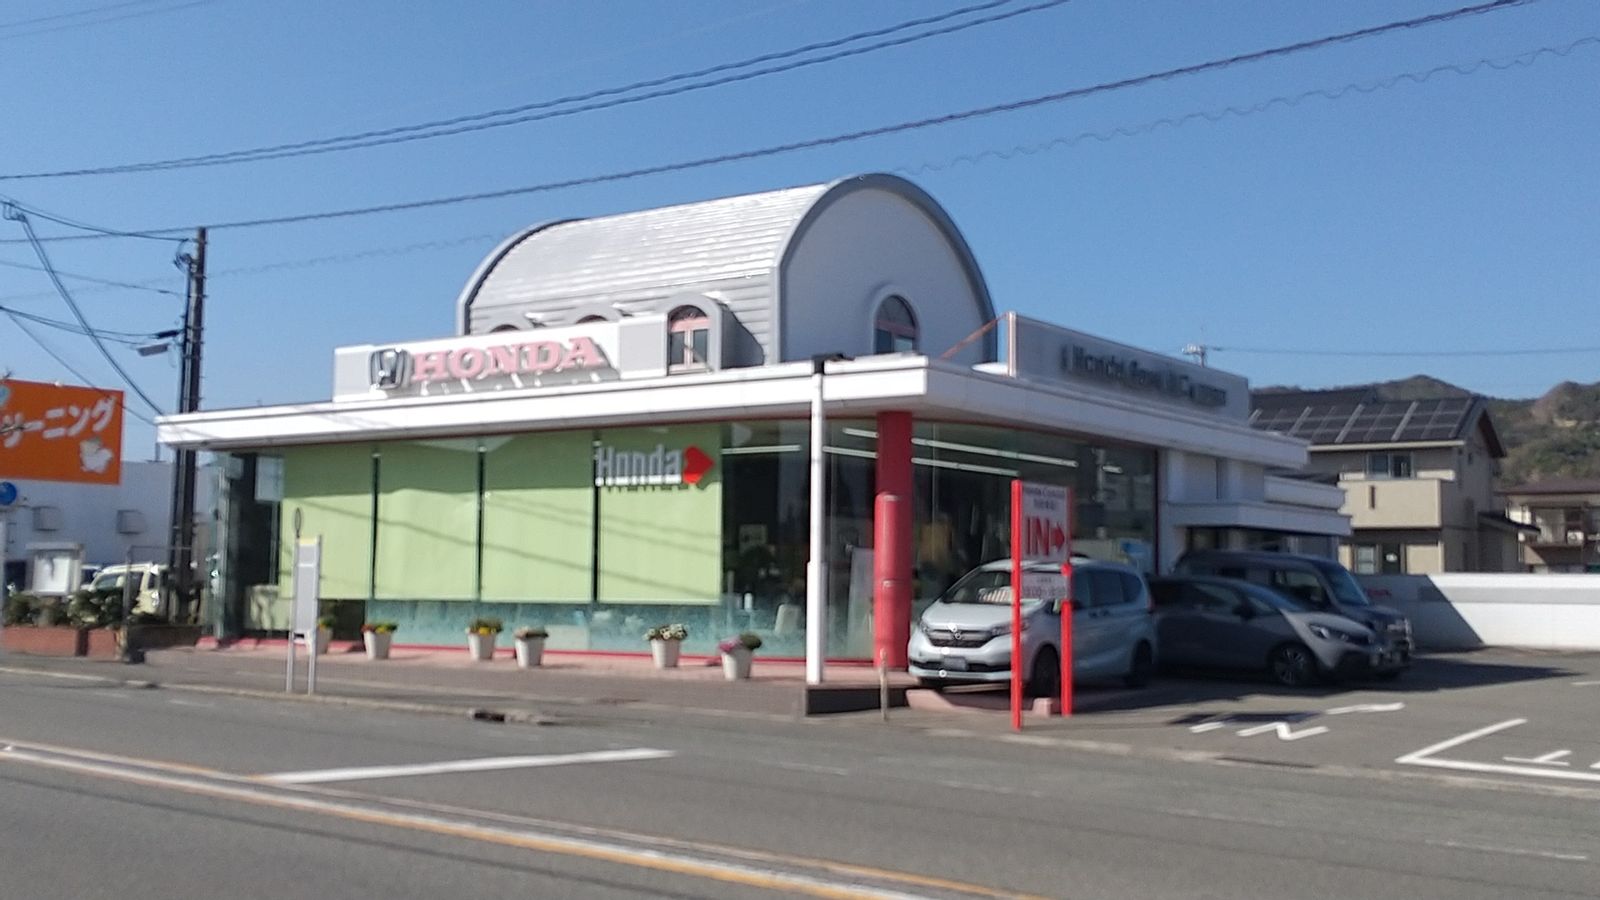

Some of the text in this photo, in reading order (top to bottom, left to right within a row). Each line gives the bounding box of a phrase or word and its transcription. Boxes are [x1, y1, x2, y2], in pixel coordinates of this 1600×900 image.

[411, 337, 605, 382] HONDA
[595, 444, 682, 486] Honda
[1025, 516, 1050, 556] IN
